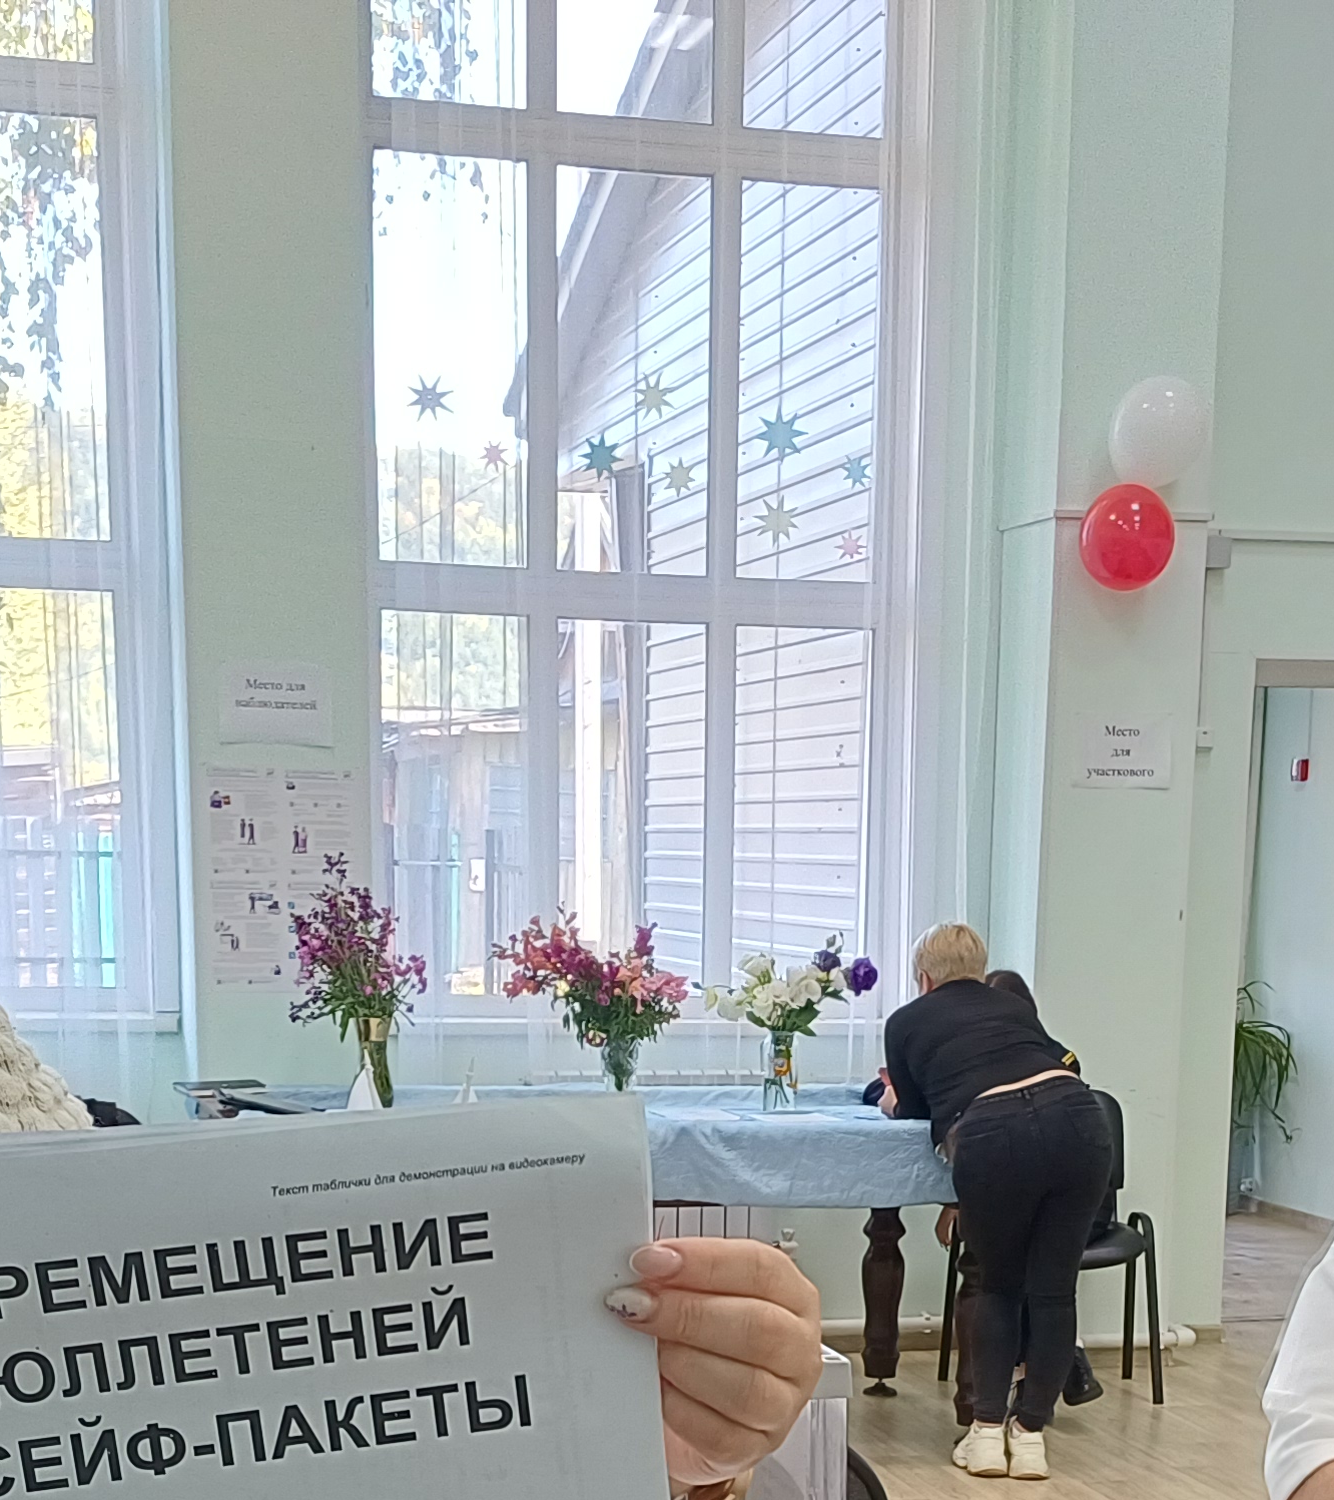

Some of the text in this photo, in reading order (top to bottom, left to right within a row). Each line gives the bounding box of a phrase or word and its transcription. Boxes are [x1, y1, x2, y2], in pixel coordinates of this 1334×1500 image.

[245, 679, 306, 691] Место для
[1104, 725, 1140, 737] Место
[1110, 748, 1131, 758] для
[1086, 768, 1154, 779] участкового
[271, 1153, 586, 1198] Текст таблички для демонстрации на видеокамеру
